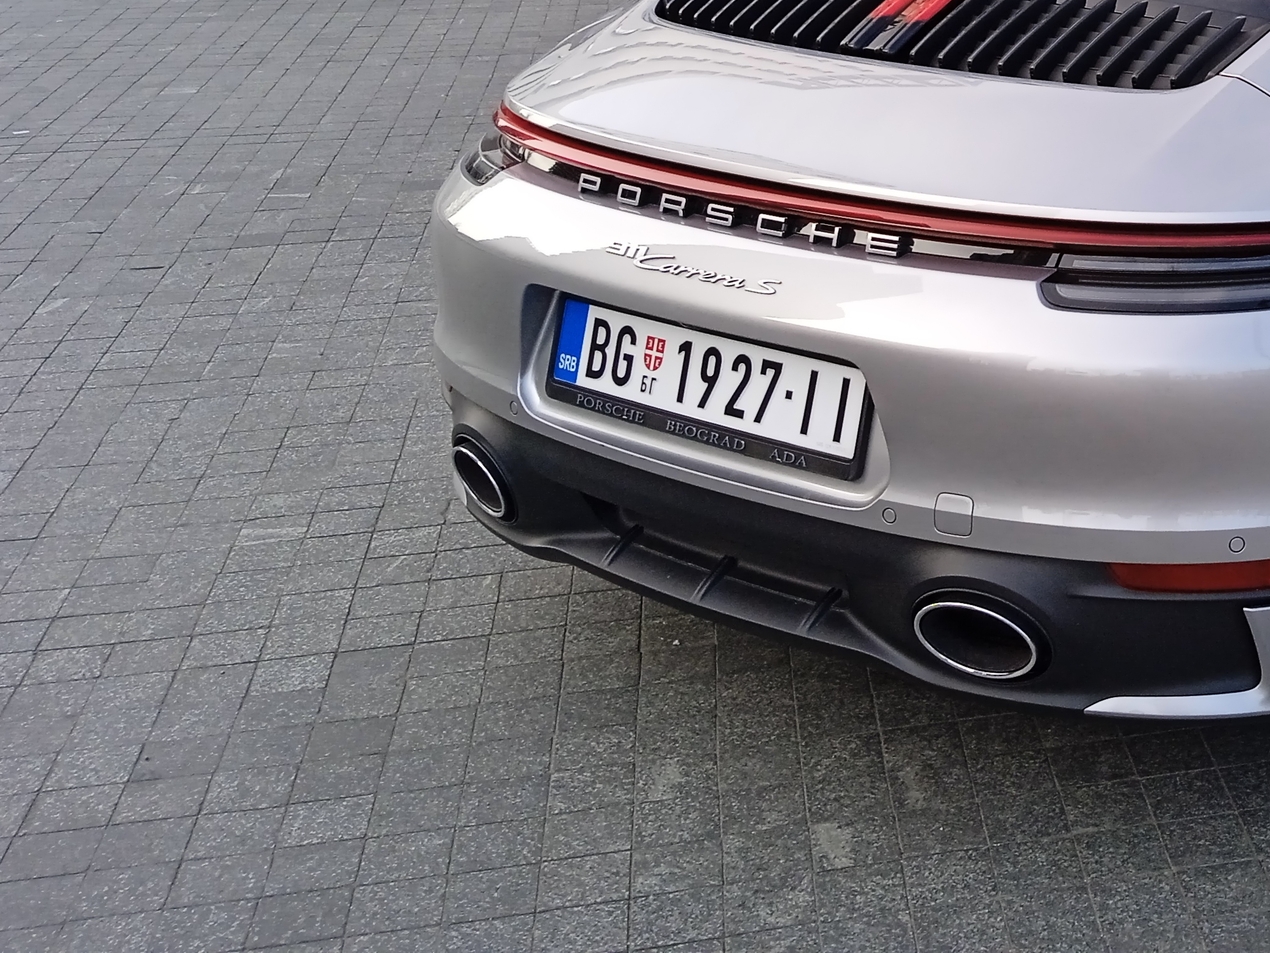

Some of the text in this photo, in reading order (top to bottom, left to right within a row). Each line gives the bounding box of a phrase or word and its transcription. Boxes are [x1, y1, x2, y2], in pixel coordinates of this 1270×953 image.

[578, 173, 902, 257] PORSCHE
[633, 254, 746, 290] Carrera
[744, 279, 783, 296] S
[558, 352, 577, 373] SRB
[585, 317, 638, 388] BG
[576, 393, 808, 468] PORSCHE BEOGRAD ADA
